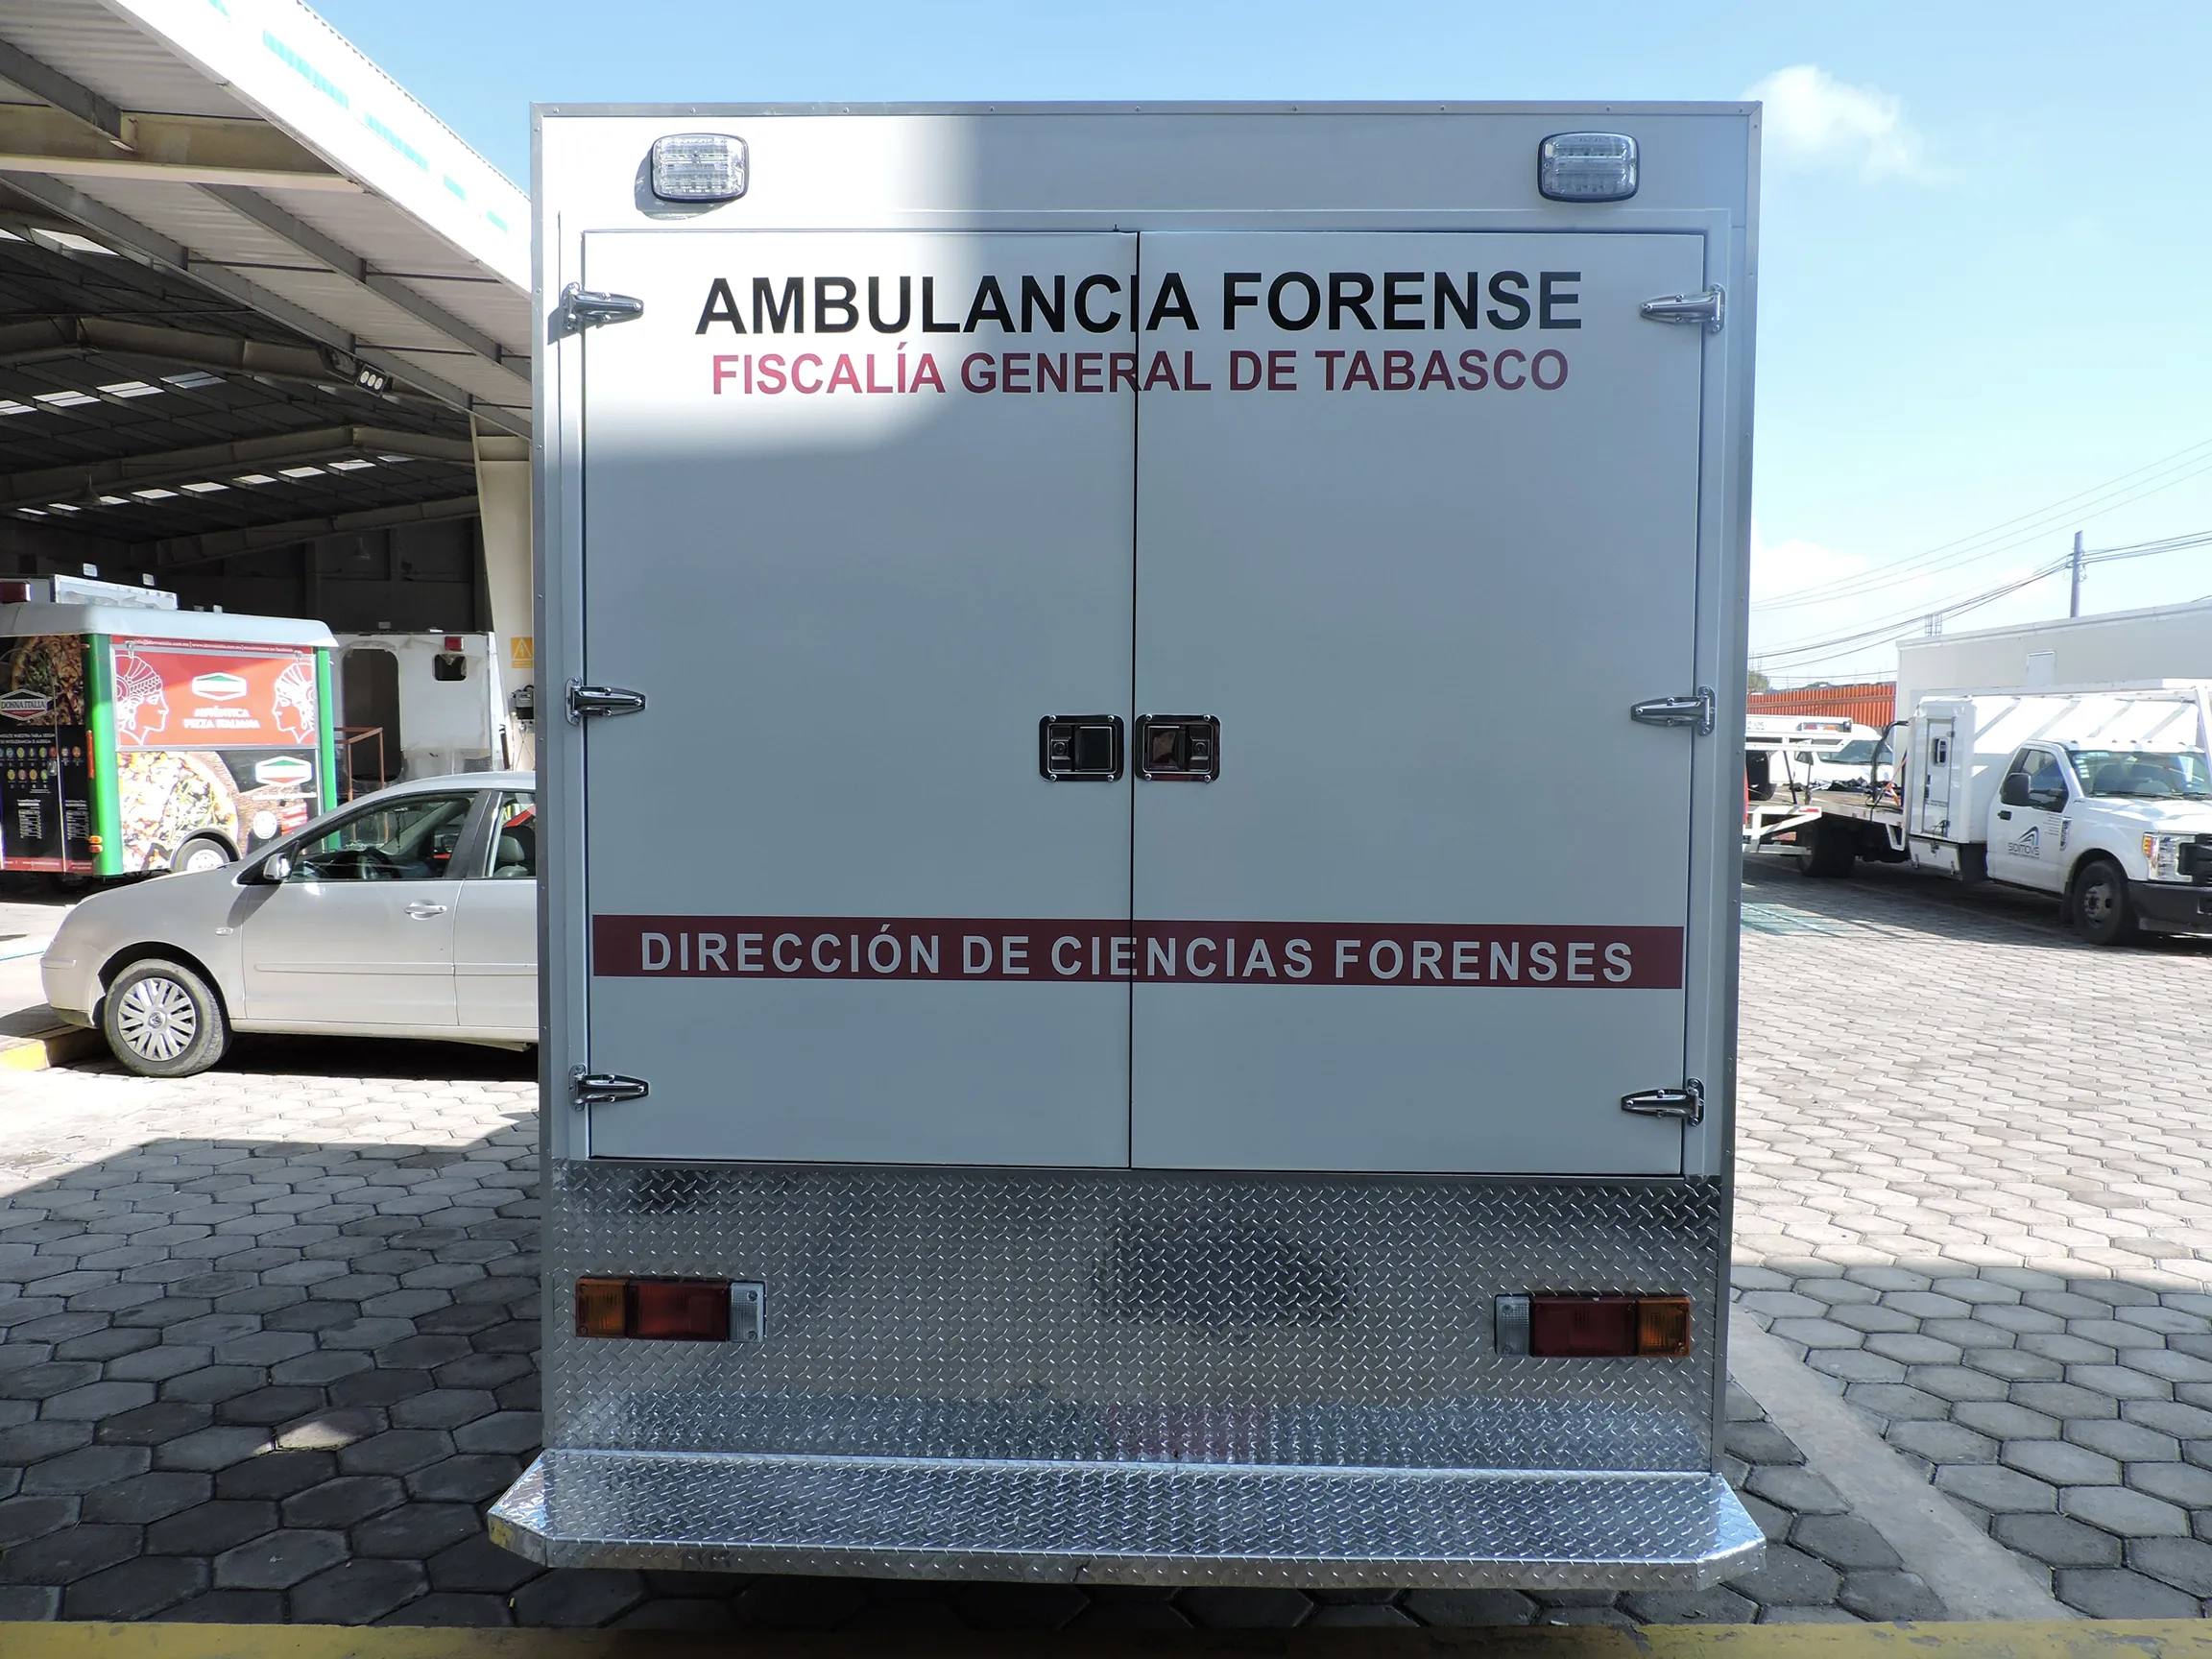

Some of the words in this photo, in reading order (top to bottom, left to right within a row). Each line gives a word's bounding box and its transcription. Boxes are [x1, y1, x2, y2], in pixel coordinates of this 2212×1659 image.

[694, 273, 1200, 335] AMBULANCIA
[1222, 271, 1582, 331] FORENSE
[712, 342, 947, 396] FISCALÍA
[960, 349, 1213, 395] GENERAL
[1229, 349, 1298, 392] DE
[1314, 349, 1569, 392] TABASCO
[641, 925, 939, 974] DIRECCIÓN
[963, 936, 1029, 975] DE
[1051, 936, 1313, 977] CIENCIAS
[1335, 939, 1633, 981] FORENSES
